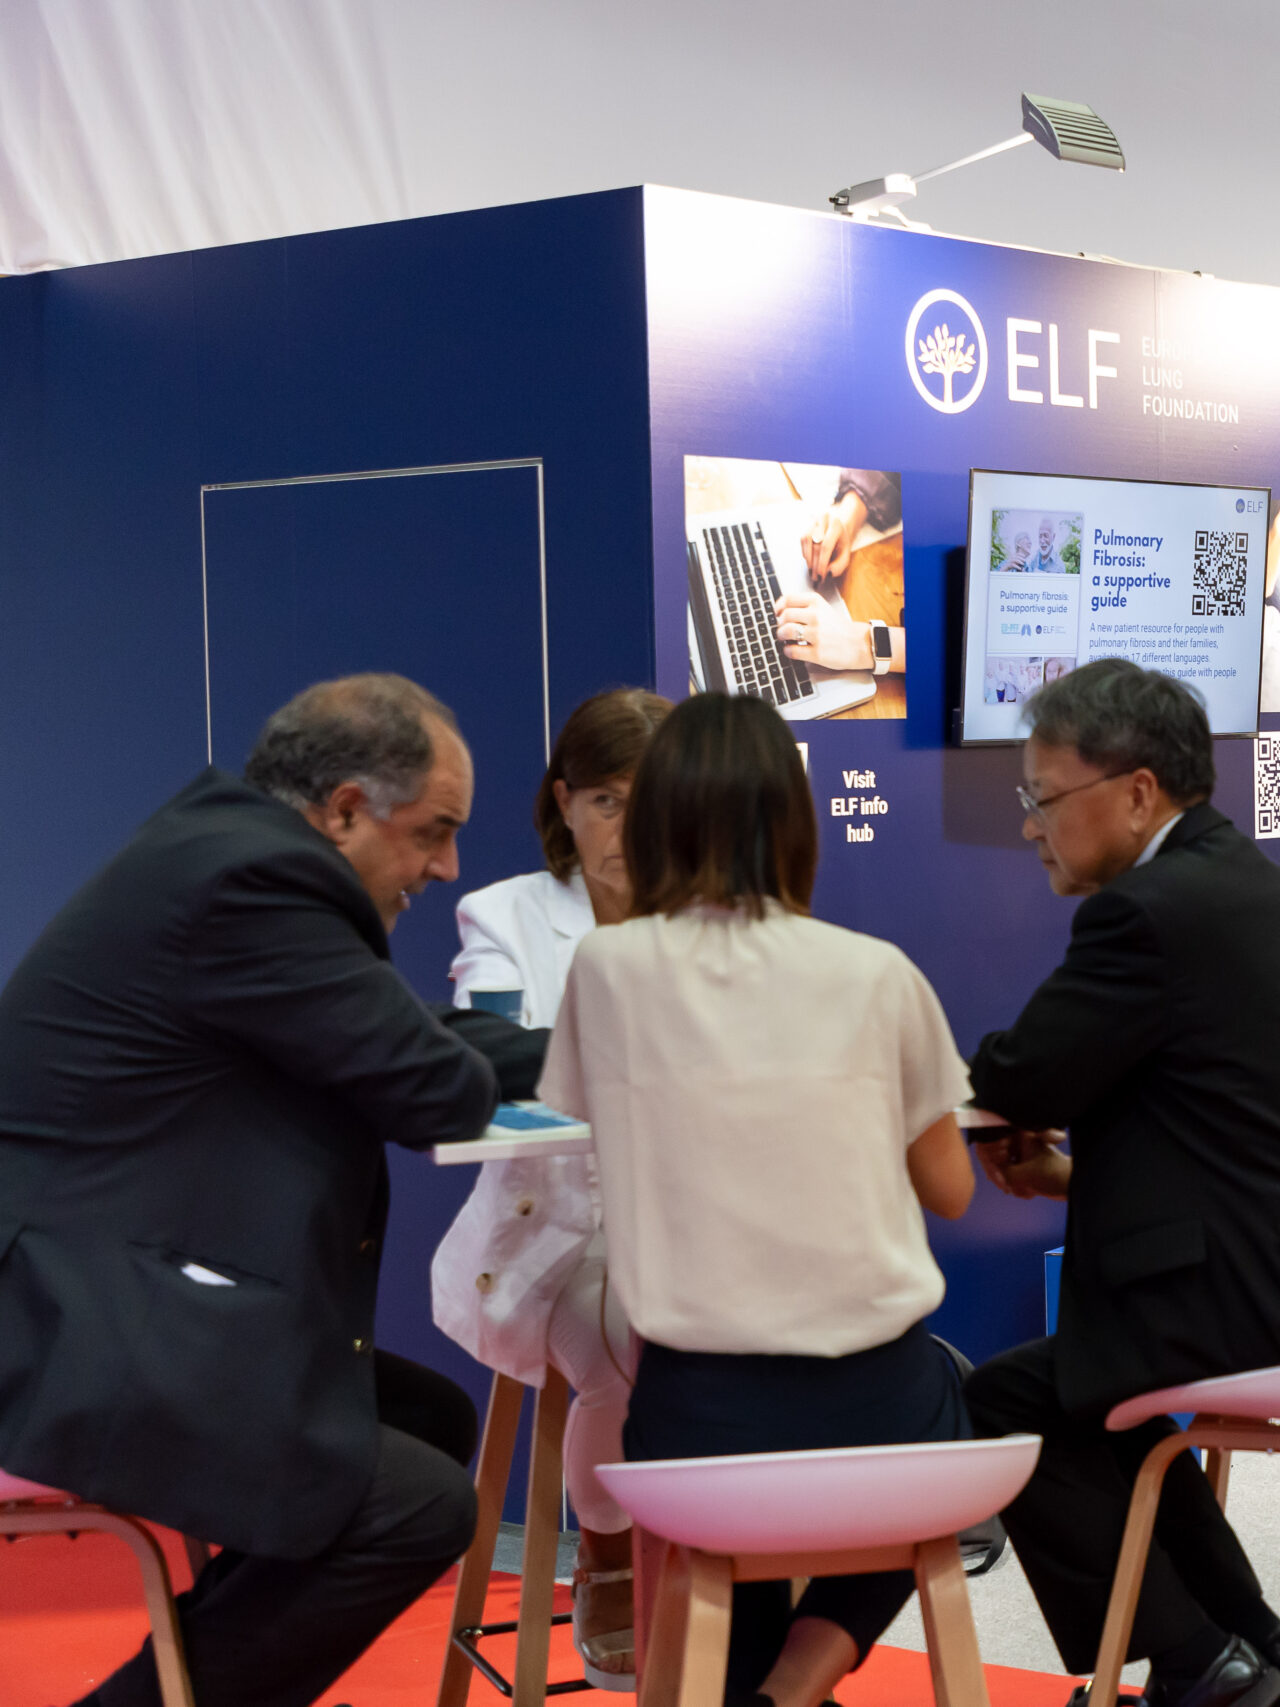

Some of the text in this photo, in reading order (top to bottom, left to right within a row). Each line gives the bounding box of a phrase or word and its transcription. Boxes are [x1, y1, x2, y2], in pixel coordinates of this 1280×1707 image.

[1006, 317, 1121, 410] ELF
[1142, 365, 1184, 391] LUNG
[1143, 394, 1239, 424] FOUNDATION
[1247, 500, 1264, 513] ELF
[1094, 528, 1164, 552] Pulmonary
[1093, 549, 1146, 567] Fibrosis:
[1092, 571, 1171, 592] a supportive
[1000, 590, 1040, 602] Pulmonary
[1091, 590, 1127, 612] guide
[1006, 603, 1046, 614] supportive
[1047, 604, 1068, 615] guide
[1089, 622, 1224, 635] A new patient resource for people with
[1089, 637, 1219, 650] pulmonary fibrosis and their families,
[1131, 652, 1141, 663] 17
[1142, 652, 1172, 663] different
[1177, 668, 1196, 680] guide
[1198, 668, 1213, 678] with
[1213, 668, 1237, 680] people
[842, 770, 876, 788] Visit
[831, 795, 888, 816] ELF info
[846, 823, 874, 843] hub
